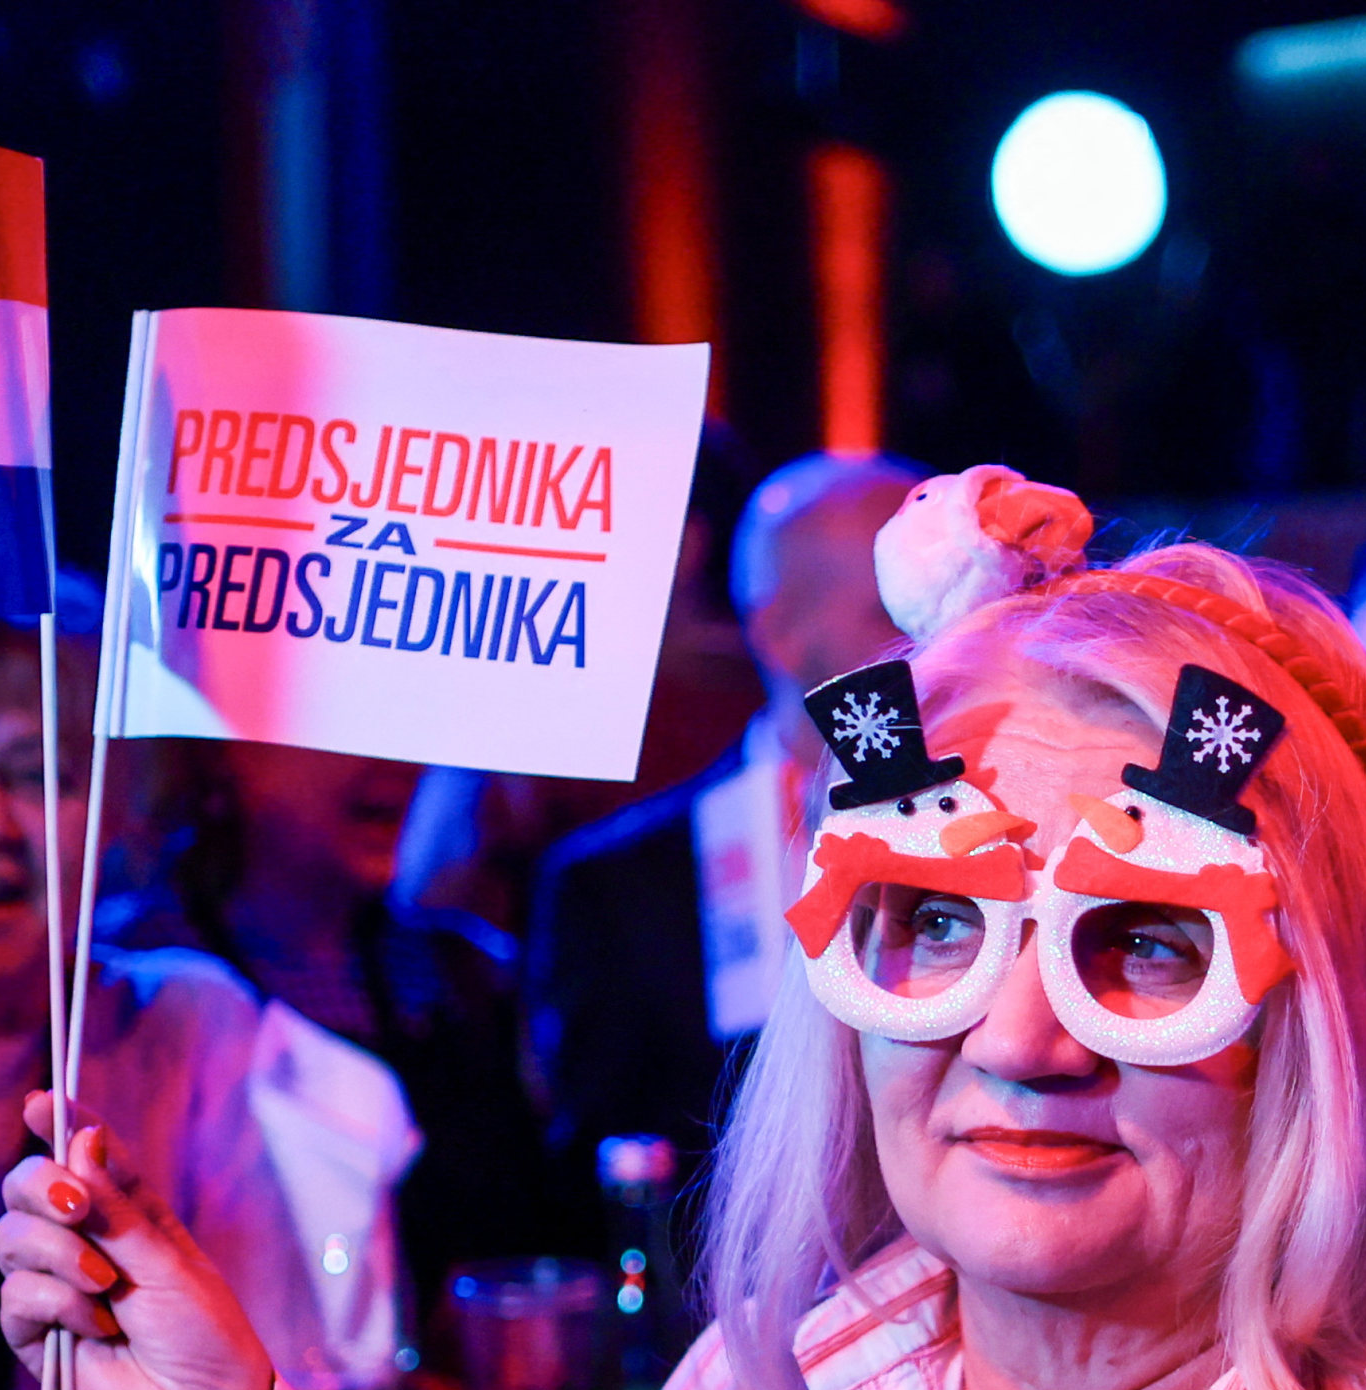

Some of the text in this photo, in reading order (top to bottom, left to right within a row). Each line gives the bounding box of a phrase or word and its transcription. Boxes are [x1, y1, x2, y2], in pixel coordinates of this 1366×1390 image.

[167, 408, 613, 533] PREDSJEDNIKA
[325, 512, 417, 556] ZA
[159, 541, 586, 669] PREDSJEDNIKA
